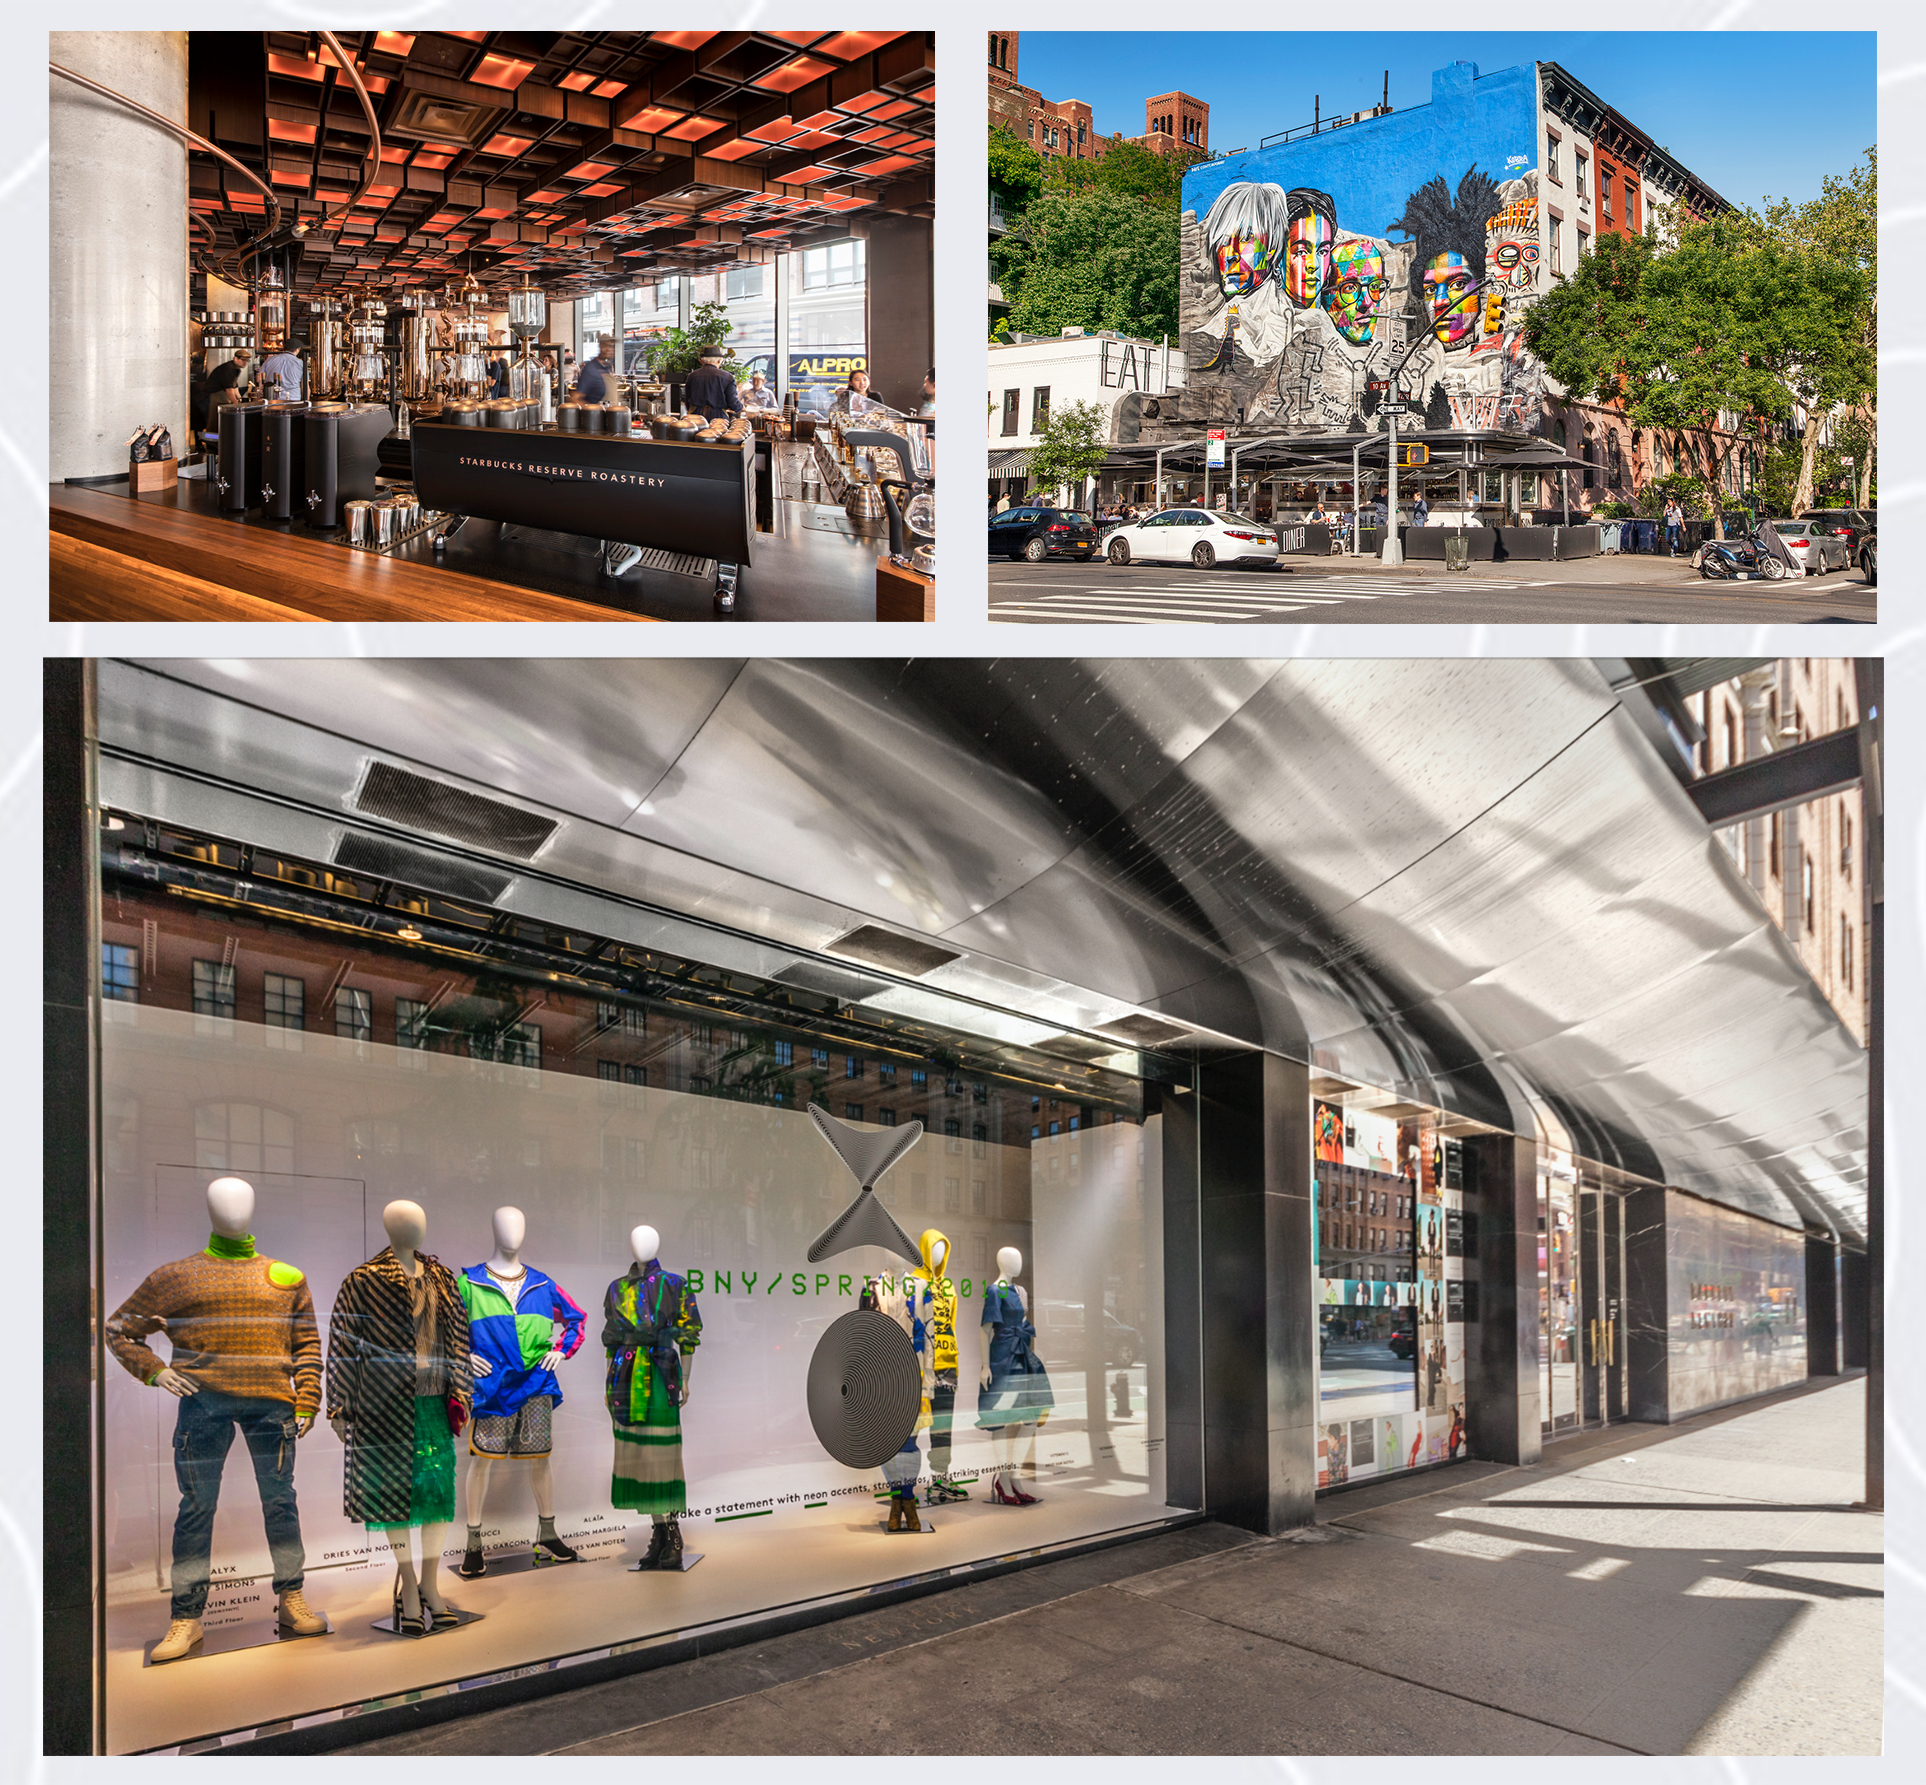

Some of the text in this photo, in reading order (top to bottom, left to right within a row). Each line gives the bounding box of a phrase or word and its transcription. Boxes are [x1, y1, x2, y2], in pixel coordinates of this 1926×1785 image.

[1392, 339, 1405, 354] 25
[797, 357, 866, 373] ALPRO
[1100, 340, 1156, 392] EAT
[459, 456, 666, 488] STARBUCKS RESERVE ROASTERY
[1283, 526, 1305, 552] DINER
[669, 1508, 701, 1520] Make
[715, 1498, 774, 1514] statement
[777, 1493, 801, 1505] with
[803, 1490, 828, 1501] neon
[830, 1484, 871, 1497] accents,
[873, 1479, 902, 1491] strong
[932, 1472, 948, 1482] and
[949, 1468, 980, 1480] striking
[981, 1462, 1020, 1475] essentials.
[475, 1529, 501, 1538] GUCCI
[562, 1525, 627, 1539] MAISON MARGIELA
[602, 1538, 626, 1546] NOTEN
[323, 1542, 406, 1560] DRIES VAN NOTEN
[210, 1566, 236, 1575] ALYX
[345, 1564, 368, 1572] Second
[215, 1579, 256, 1592] SIMONS
[230, 1595, 260, 1605] KLEIN
[203, 1619, 223, 1627] Third
